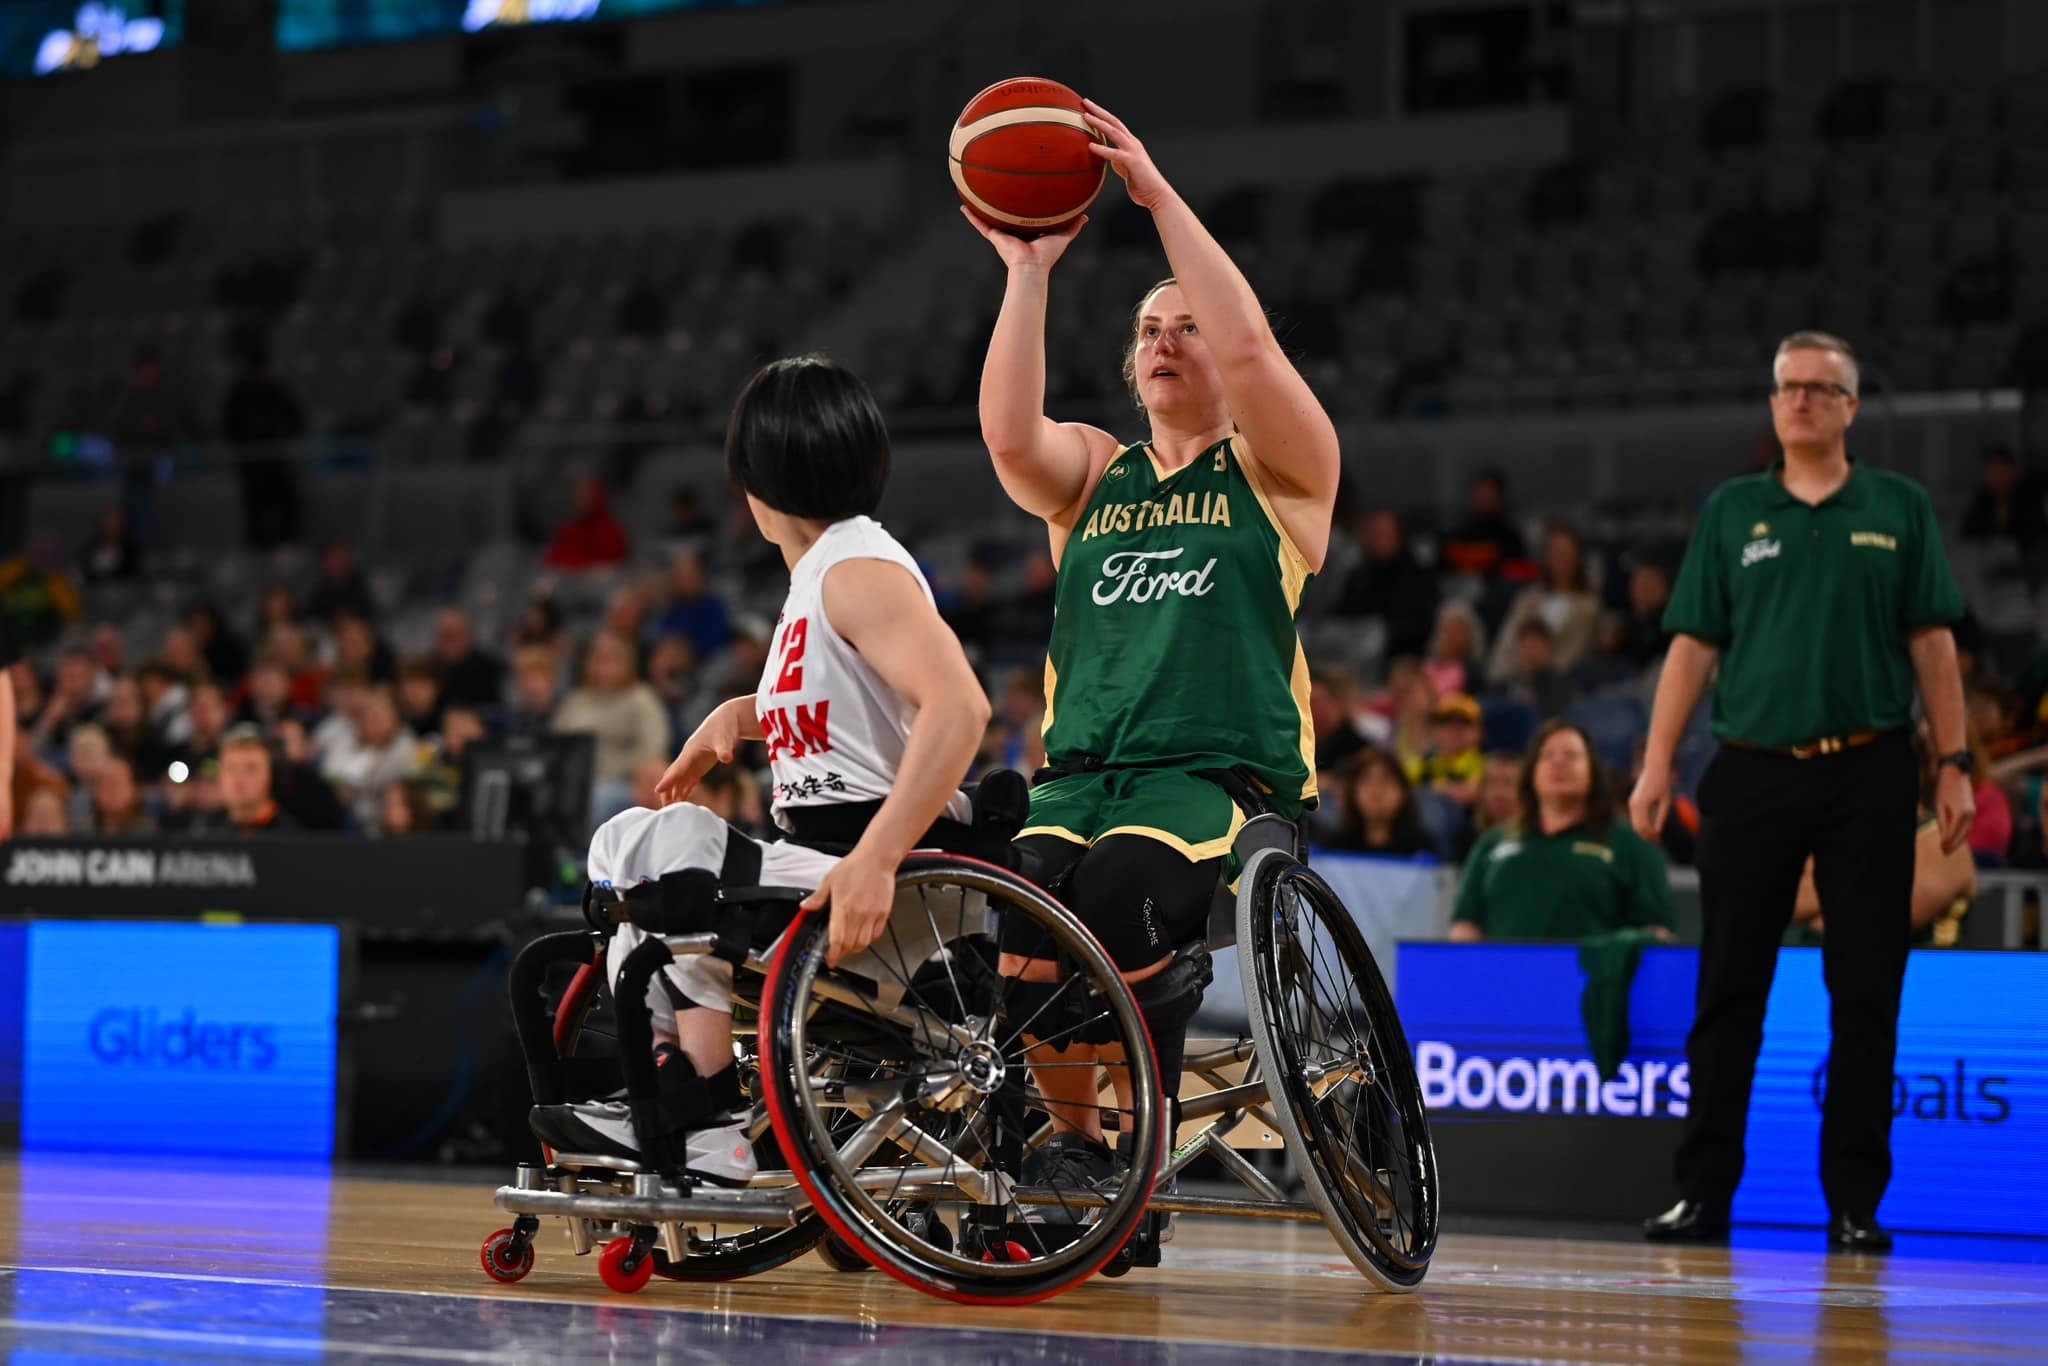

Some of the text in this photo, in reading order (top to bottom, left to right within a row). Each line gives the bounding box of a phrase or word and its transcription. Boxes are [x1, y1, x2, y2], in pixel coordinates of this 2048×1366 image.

[1081, 490, 1231, 542] AUSTRALIA
[1092, 547, 1218, 606] Ford
[6, 850, 82, 886] JOHN
[87, 850, 155, 886] CAIN
[89, 1006, 279, 1072] Gliders
[1416, 1040, 1691, 1117] Boomers
[1812, 1059, 2011, 1124] als
